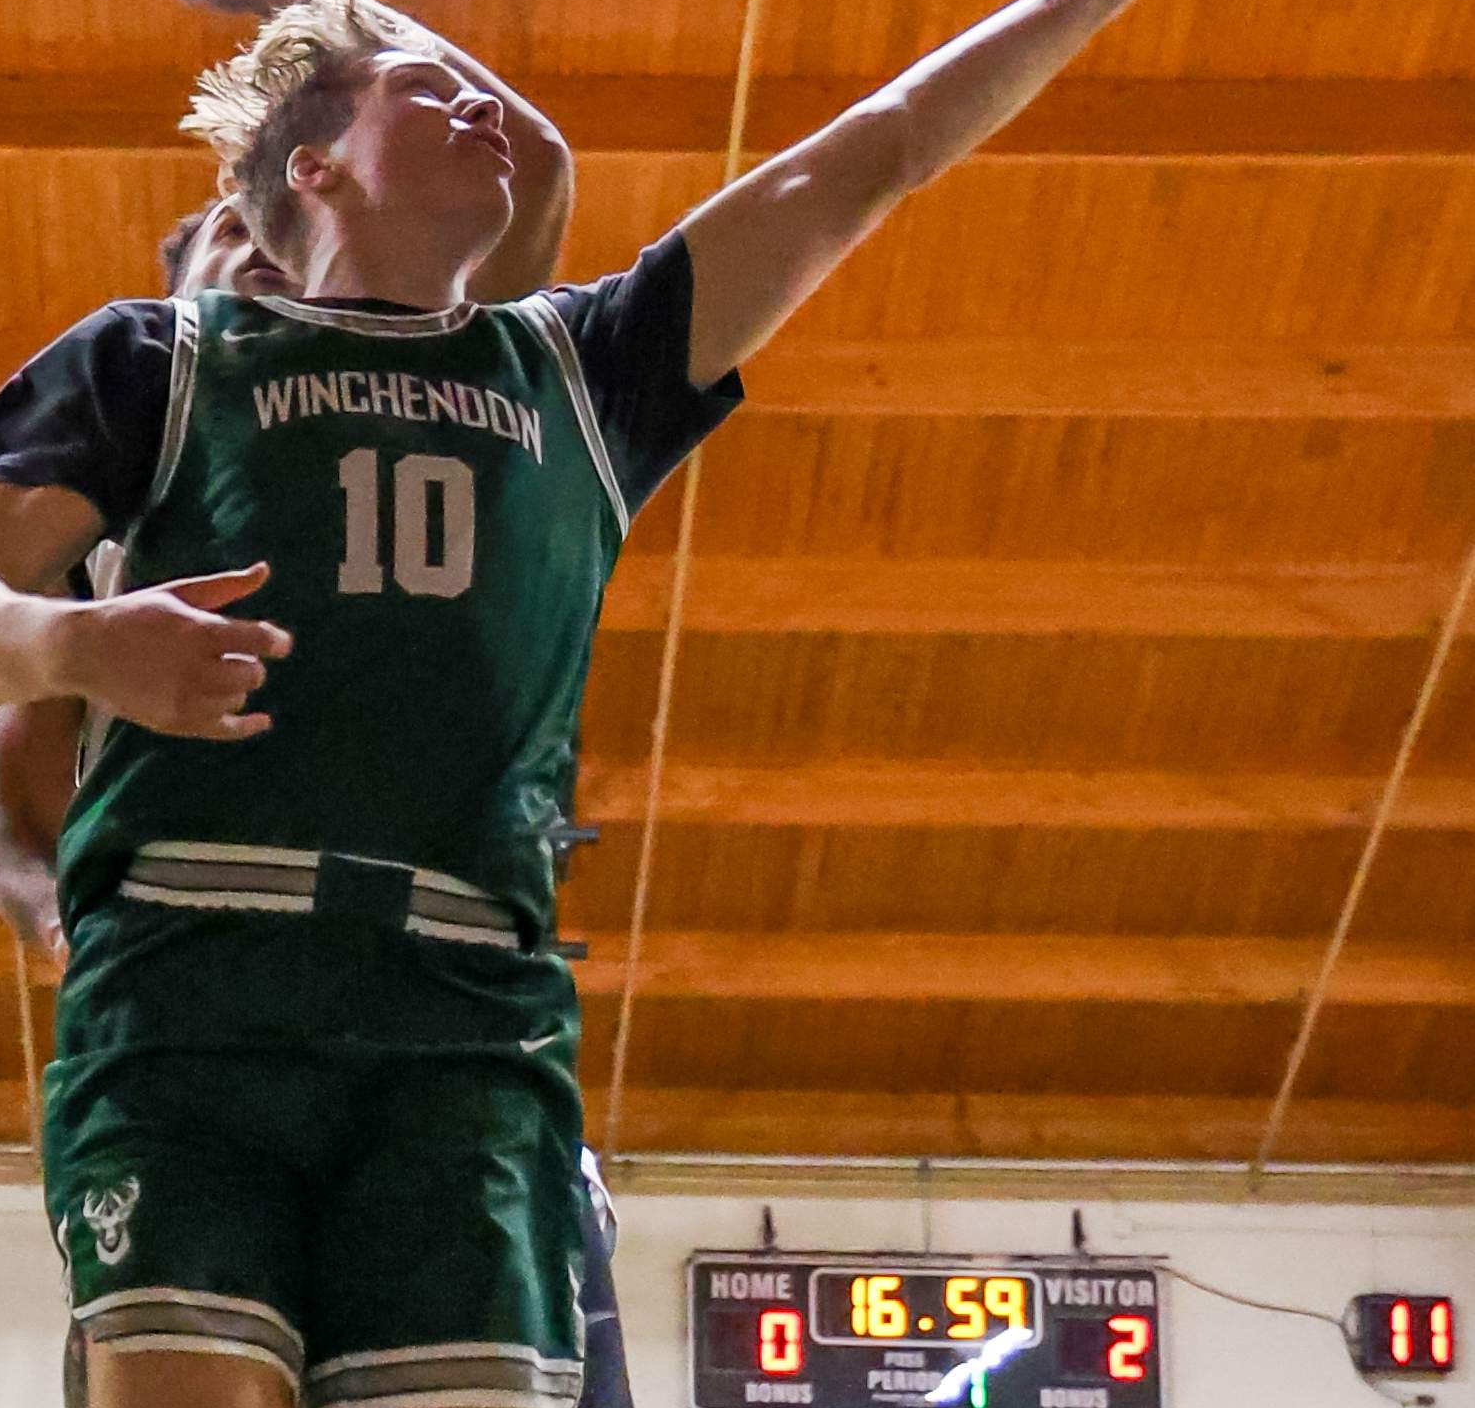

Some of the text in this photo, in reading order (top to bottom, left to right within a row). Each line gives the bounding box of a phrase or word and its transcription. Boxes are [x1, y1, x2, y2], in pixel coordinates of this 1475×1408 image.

[252, 370, 543, 465] WINCHENDON
[337, 446, 475, 599] 10
[709, 1272, 792, 1300] HOME
[1044, 1278, 1155, 1307] VISITOR
[758, 1307, 803, 1376] 0
[1107, 1314, 1152, 1381] 2
[1388, 1298, 1452, 1366] 11
[744, 1381, 814, 1405] BONUS
